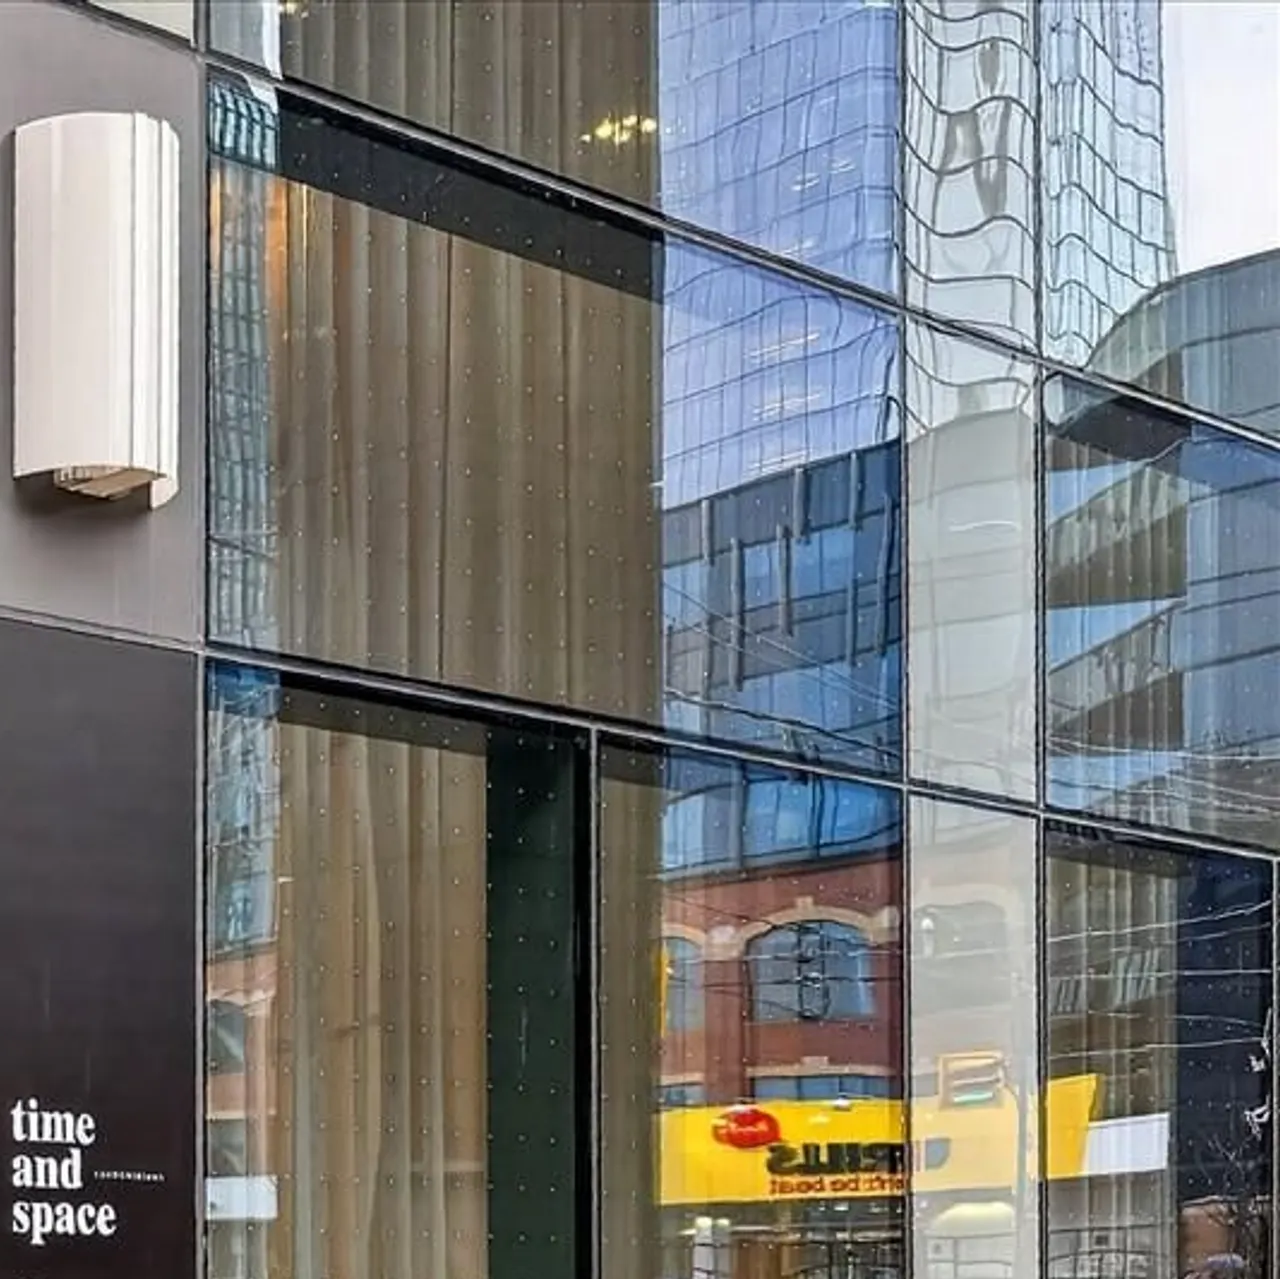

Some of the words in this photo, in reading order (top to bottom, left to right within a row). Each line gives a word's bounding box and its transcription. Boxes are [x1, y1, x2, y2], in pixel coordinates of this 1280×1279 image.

[10, 1097, 96, 1146] time
[11, 1147, 83, 1189] and
[11, 1201, 119, 1246] space
